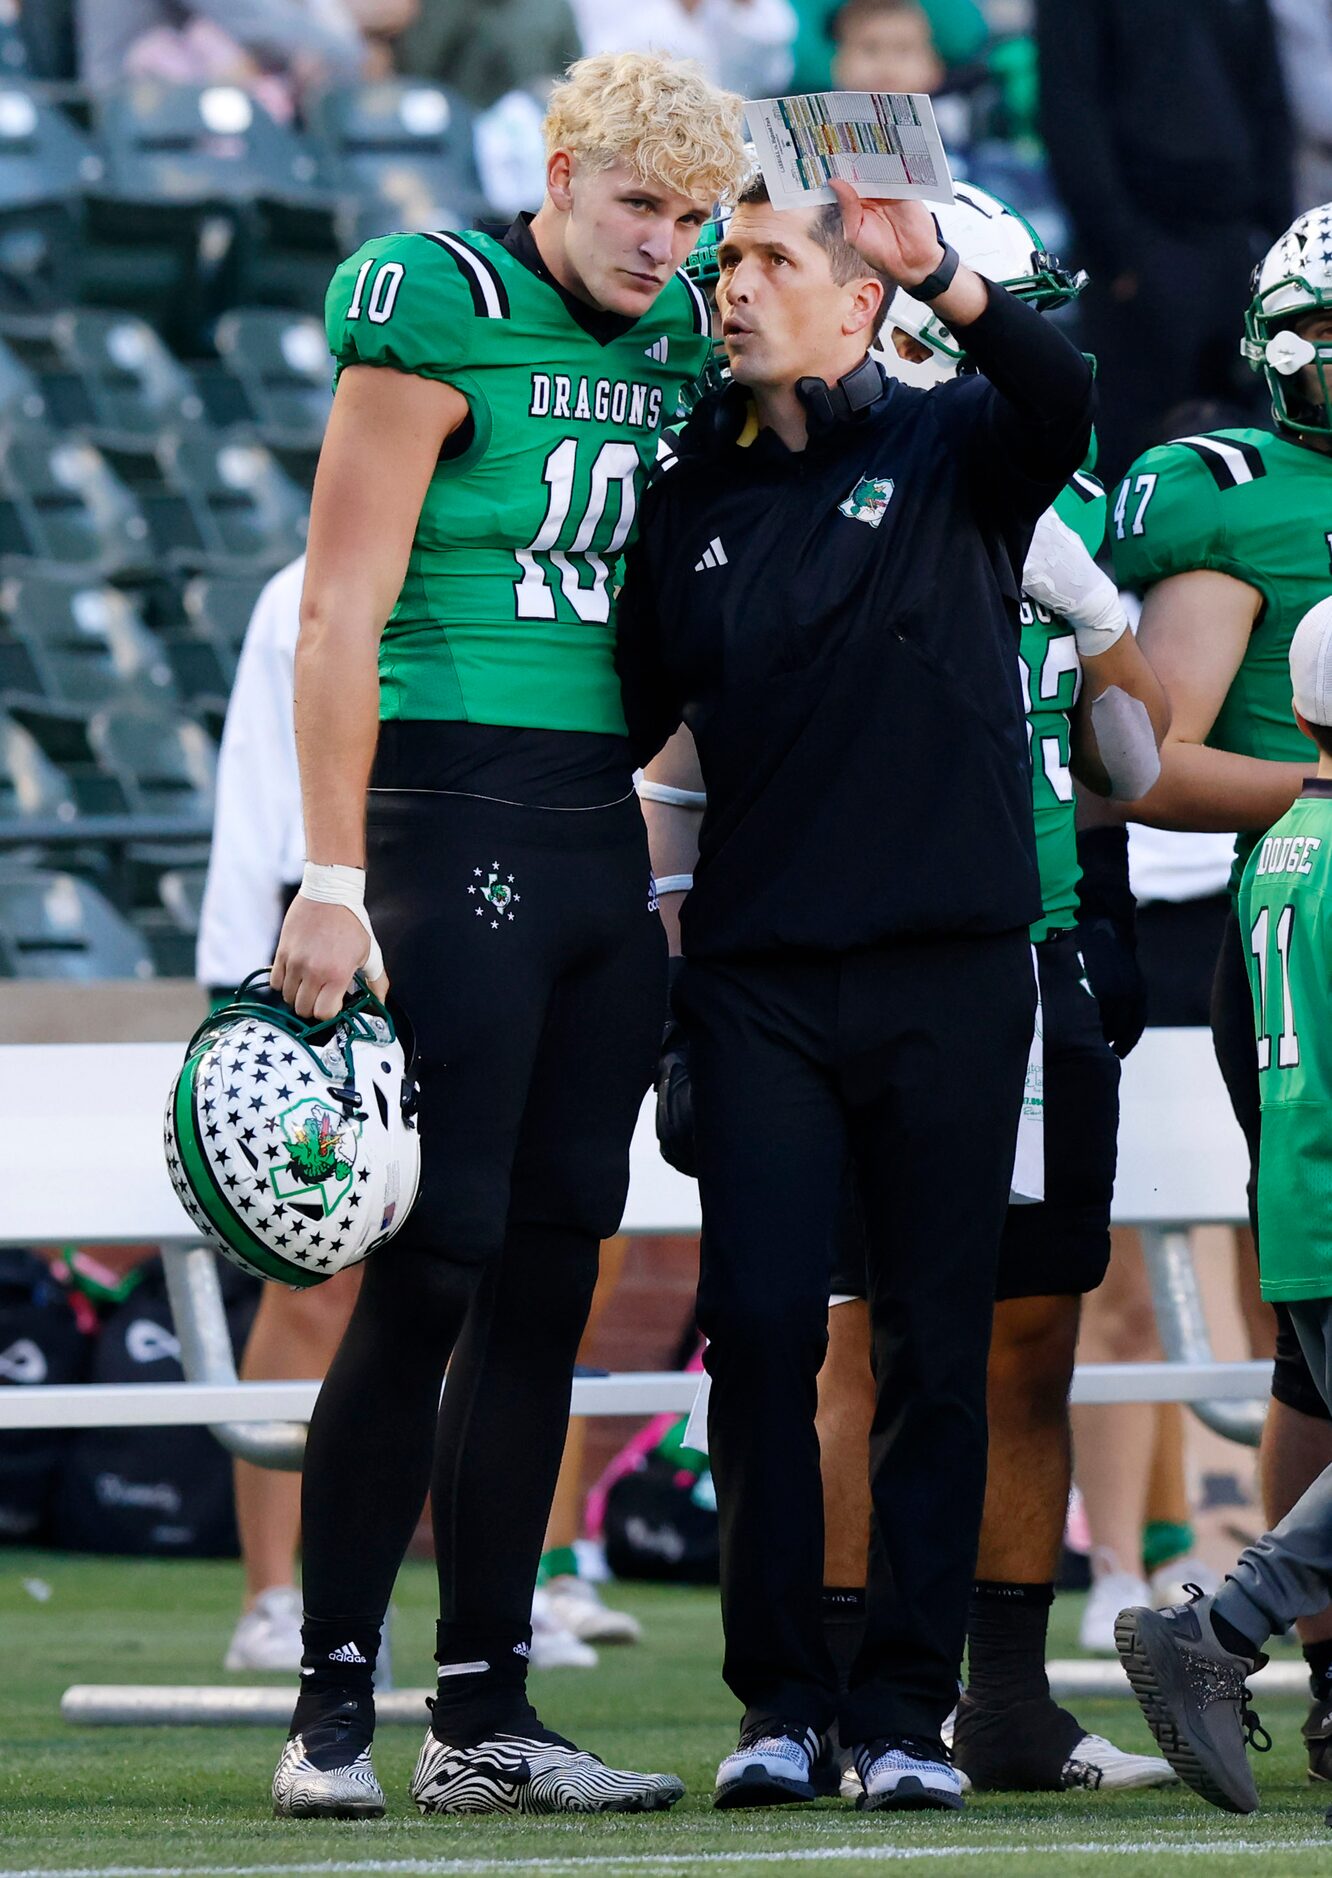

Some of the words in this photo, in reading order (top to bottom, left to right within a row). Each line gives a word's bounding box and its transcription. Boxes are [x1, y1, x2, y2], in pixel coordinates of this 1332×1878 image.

[346, 258, 406, 325] 10
[528, 373, 663, 429] DRAGONS
[513, 437, 640, 624] 10
[1113, 473, 1159, 540] 47
[1256, 835, 1322, 876] DODGE
[1251, 904, 1300, 1072] 11
[328, 1653, 367, 1663] adidas
